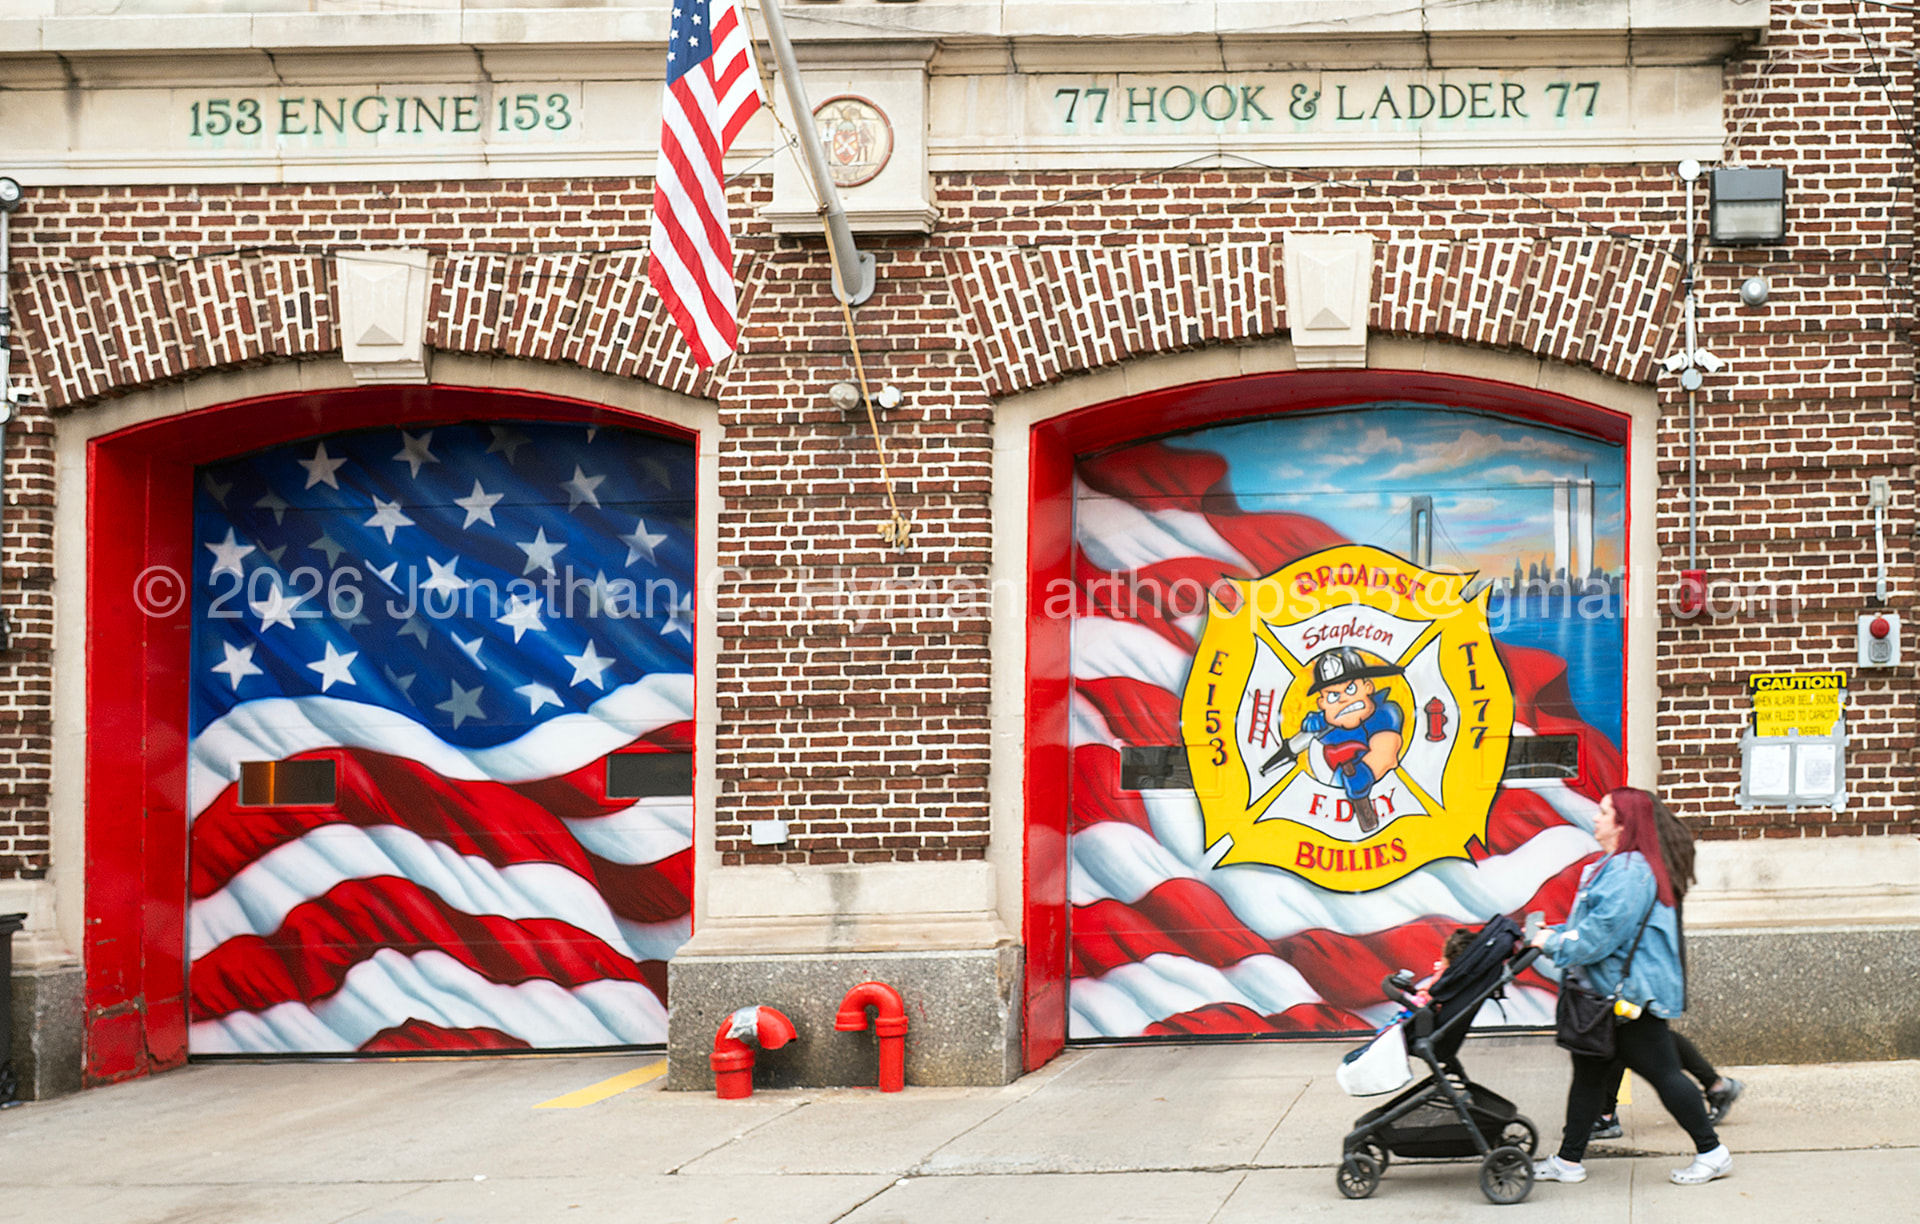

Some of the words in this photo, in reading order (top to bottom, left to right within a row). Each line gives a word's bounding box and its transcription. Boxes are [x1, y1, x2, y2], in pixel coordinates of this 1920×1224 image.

[190, 99, 263, 137] 153
[278, 96, 482, 135] ENGINE
[498, 94, 572, 131] 153
[1056, 88, 1109, 123] 77
[1126, 85, 1273, 122] HOOK
[1289, 83, 1322, 120] &
[1336, 82, 1528, 120] LADDER
[1546, 82, 1601, 117] 77
[1294, 562, 1390, 596] BROAD
[1391, 572, 1426, 602] ST
[1302, 616, 1394, 650] Stapleton
[1458, 641, 1492, 750] TL77
[1757, 676, 1838, 690] CAUTION
[1295, 838, 1407, 872] BULLIES
